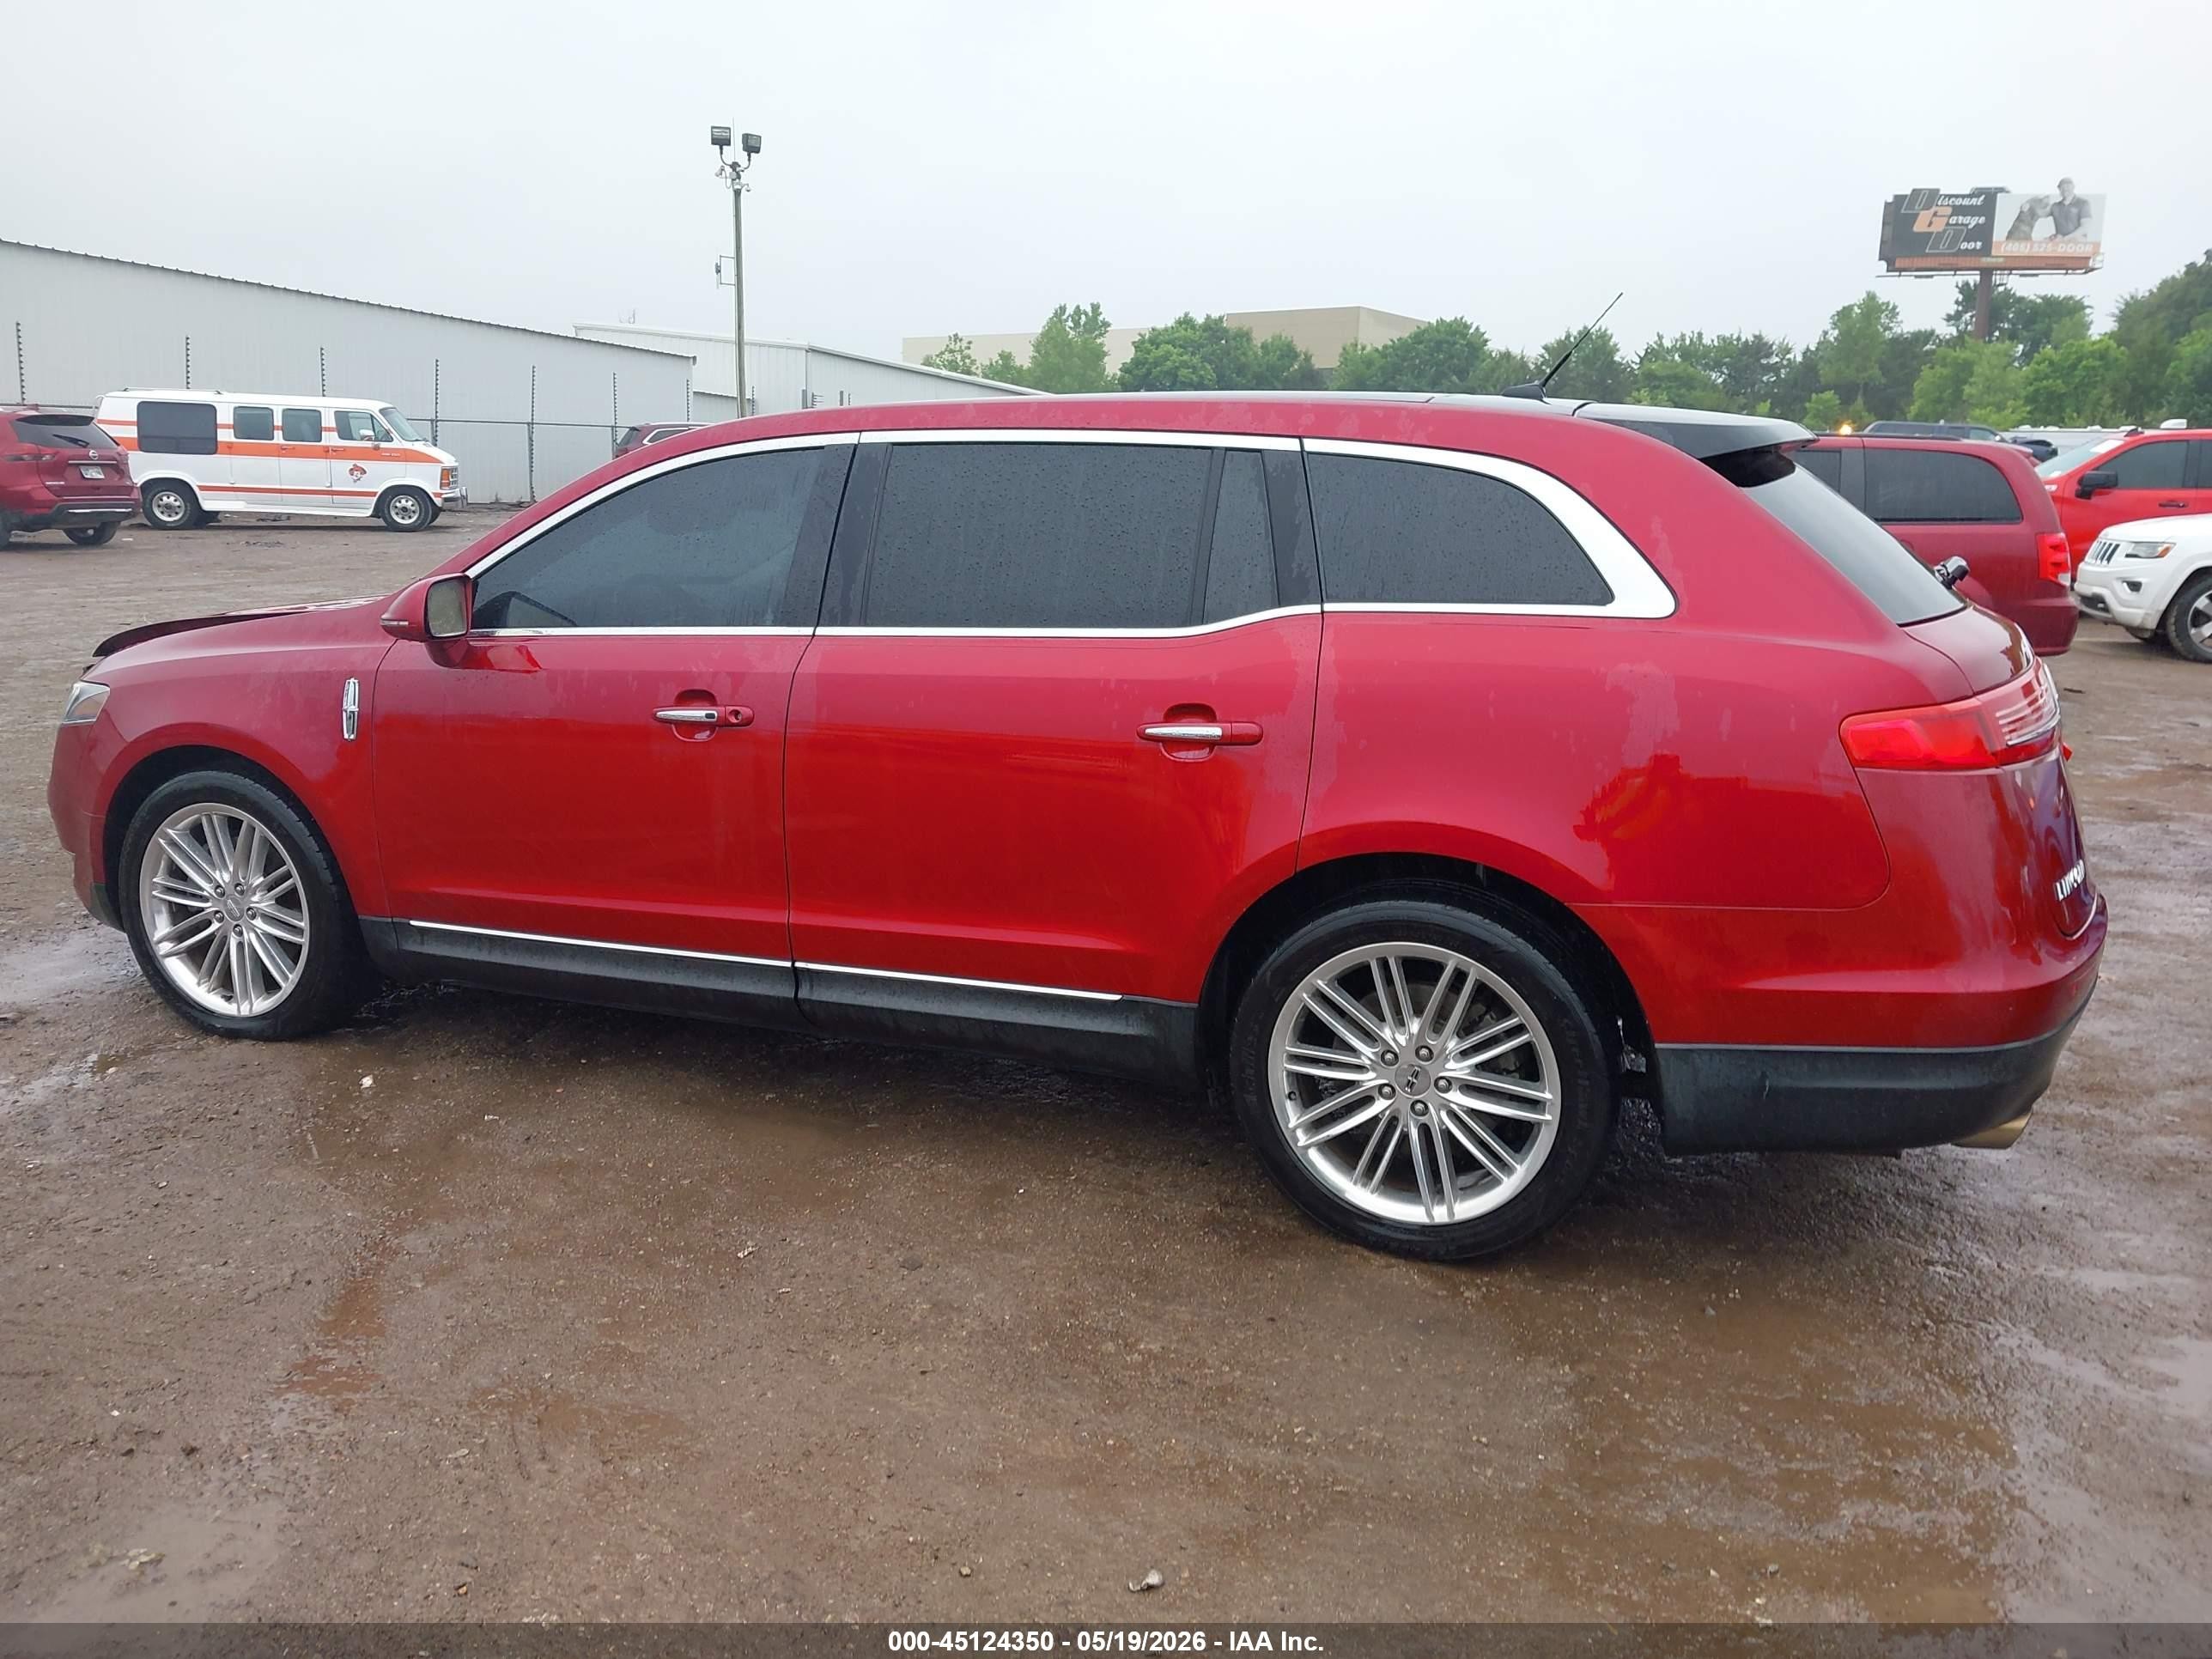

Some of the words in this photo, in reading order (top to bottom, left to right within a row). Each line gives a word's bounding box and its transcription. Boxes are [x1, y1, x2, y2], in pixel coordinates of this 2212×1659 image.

[1901, 188, 1985, 213] Discount
[1913, 206, 1985, 233] Garage
[1926, 226, 1983, 252] Door
